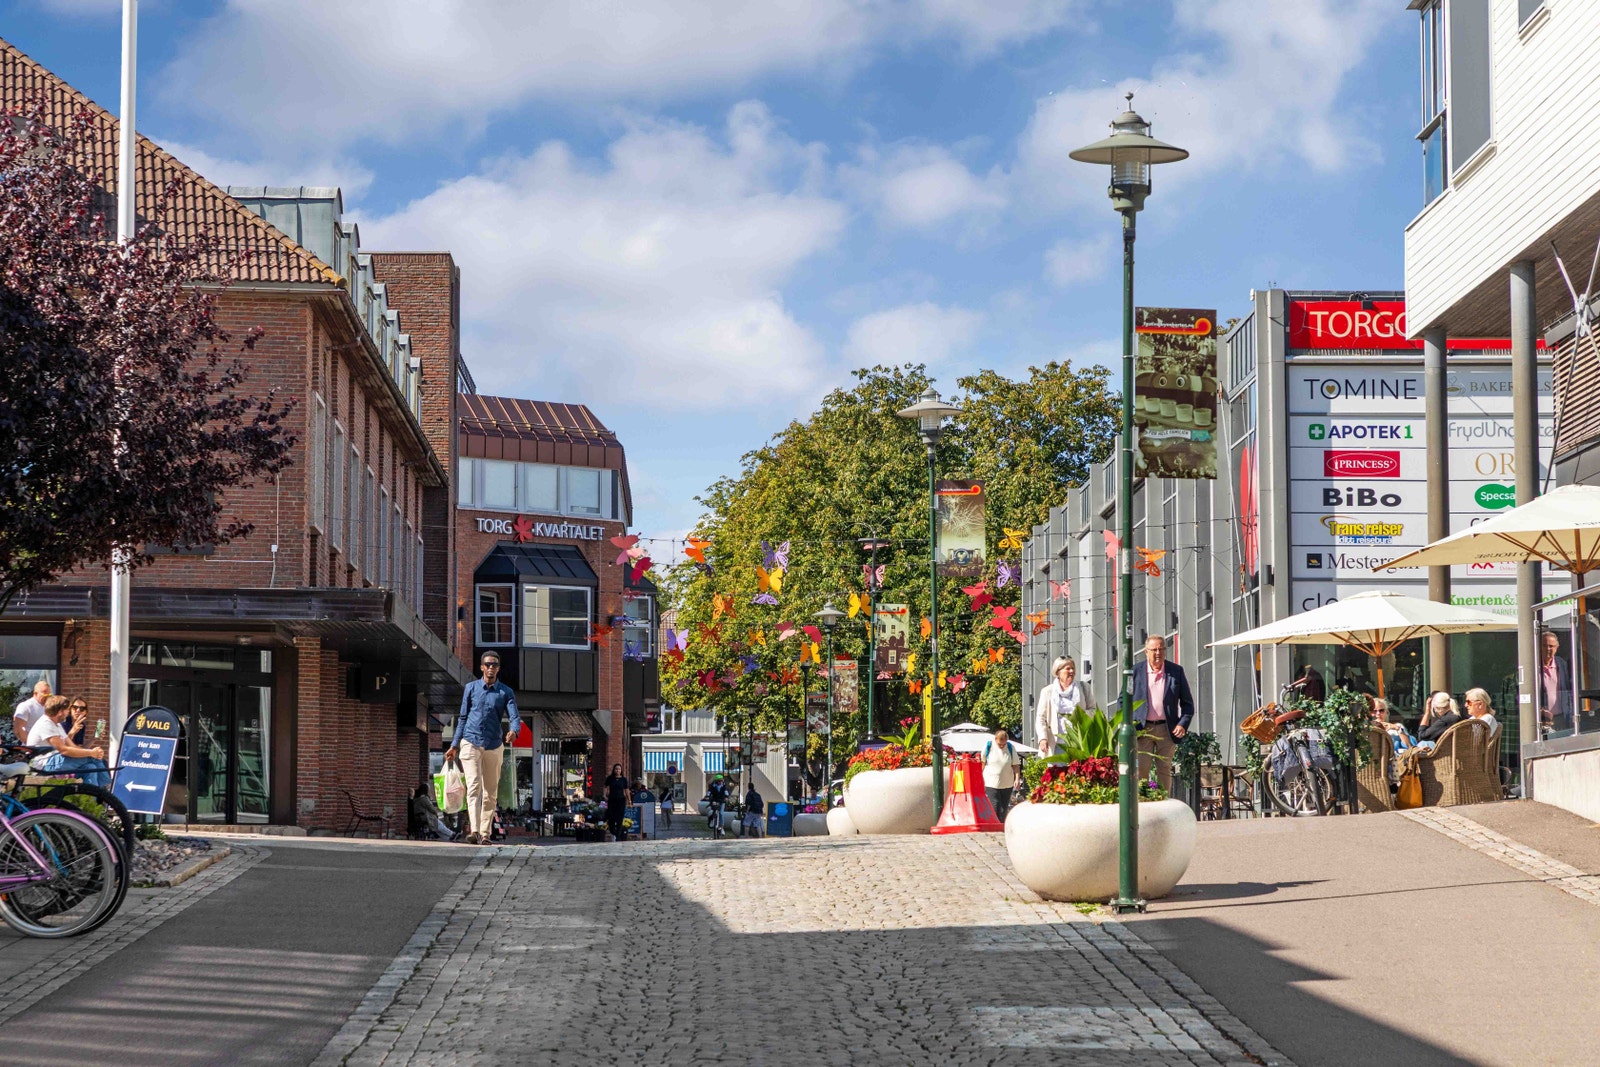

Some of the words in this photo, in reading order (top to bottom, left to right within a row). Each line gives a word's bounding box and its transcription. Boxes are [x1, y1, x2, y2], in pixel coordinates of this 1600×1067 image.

[1304, 379, 1417, 400] TOMINE
[1328, 425, 1401, 439] APOTEK
[1404, 425, 1414, 439] 1
[1340, 459, 1390, 469] PRINCESS
[1475, 452, 1516, 476] OR
[1323, 487, 1402, 507] BiBo
[1480, 491, 1515, 502] Specsa
[476, 518, 513, 534] TORG
[536, 523, 605, 540] KVARTALET
[1329, 521, 1364, 536] Trans
[1365, 522, 1404, 536] reiser
[1327, 553, 1419, 574] Mesterg
[147, 721, 170, 730] VALG
[138, 741, 149, 749] Her
